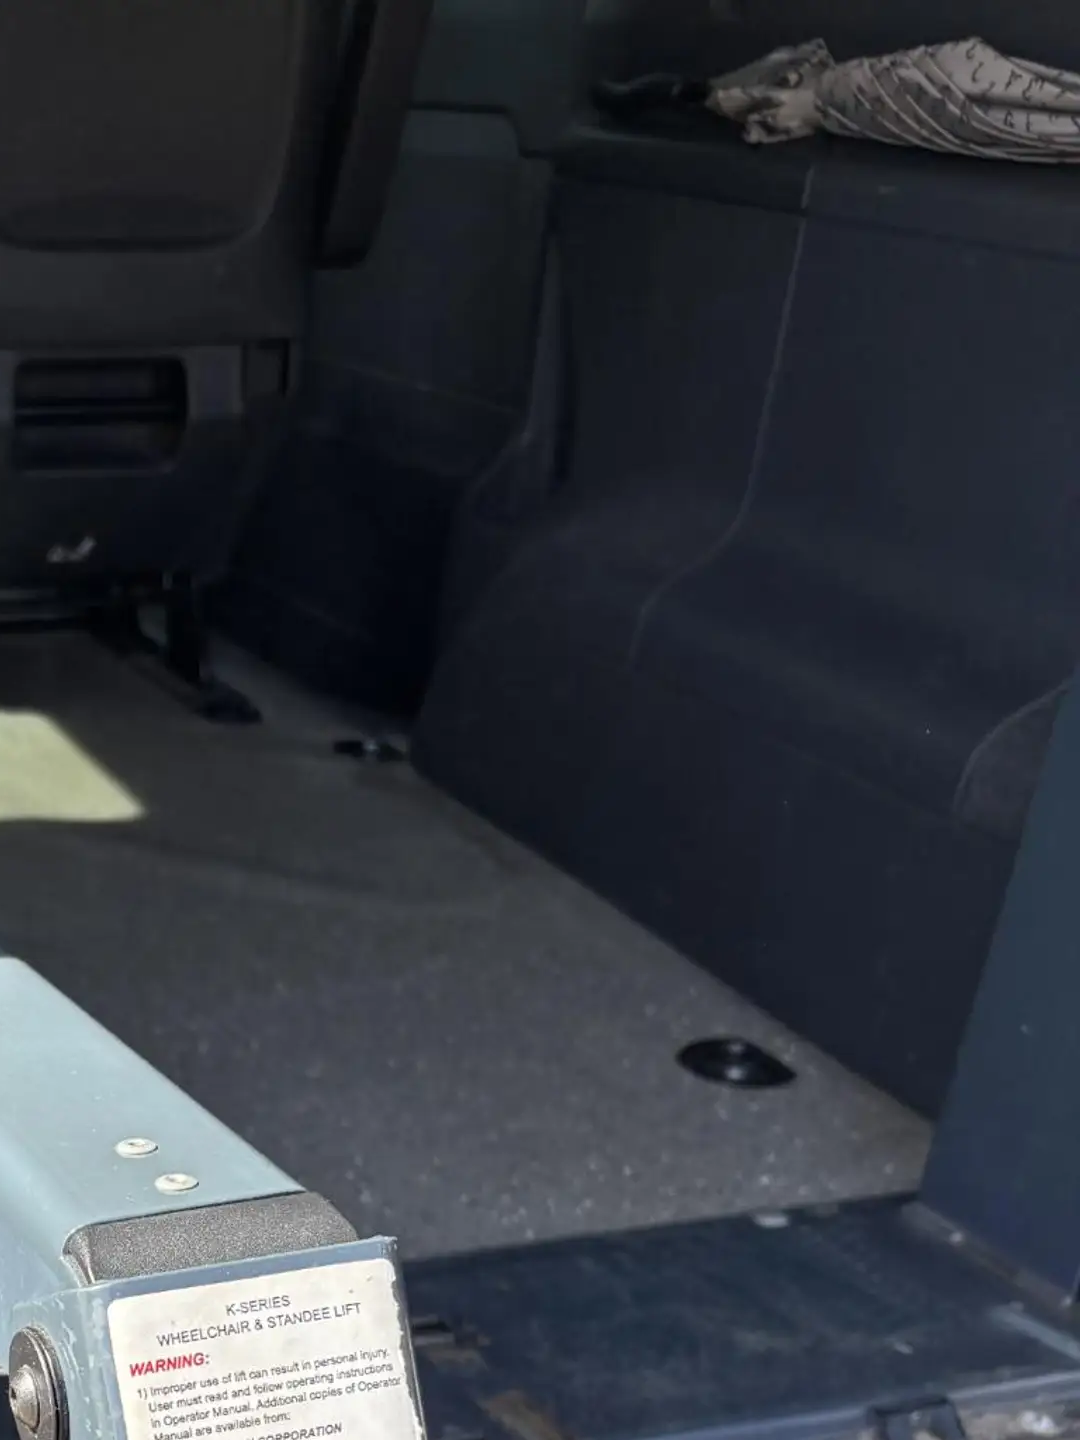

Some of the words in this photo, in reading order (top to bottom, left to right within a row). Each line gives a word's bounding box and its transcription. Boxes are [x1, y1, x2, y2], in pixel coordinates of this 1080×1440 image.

[156, 1320, 251, 1347] WHEELCHAIR
[254, 1318, 264, 1331] &
[266, 1306, 331, 1329] STANDEE
[333, 1302, 361, 1318] LIFT
[225, 1294, 291, 1316] K-SERIES
[129, 1352, 210, 1377] WARNING:
[136, 1387, 148, 1401] 1)
[149, 1381, 197, 1397] Improper
[199, 1377, 220, 1389] use
[221, 1372, 232, 1385] of
[233, 1370, 248, 1383] lift
[248, 1369, 269, 1380] can
[270, 1361, 300, 1376] result
[301, 1360, 312, 1371] in
[313, 1351, 358, 1371] personal
[148, 1400, 174, 1414] User
[176, 1395, 203, 1408] must
[204, 1389, 229, 1404] read
[231, 1385, 252, 1399] and
[252, 1382, 284, 1395] follow
[285, 1373, 335, 1390] operating
[336, 1363, 394, 1380] instructions
[150, 1418, 162, 1429] in
[163, 1410, 211, 1427] Operator
[256, 1391, 307, 1411] Additional
[309, 1387, 343, 1401] copies
[344, 1382, 356, 1395] of
[357, 1377, 401, 1392] Operator
[195, 1426, 213, 1437] are
[215, 1416, 262, 1433] available
